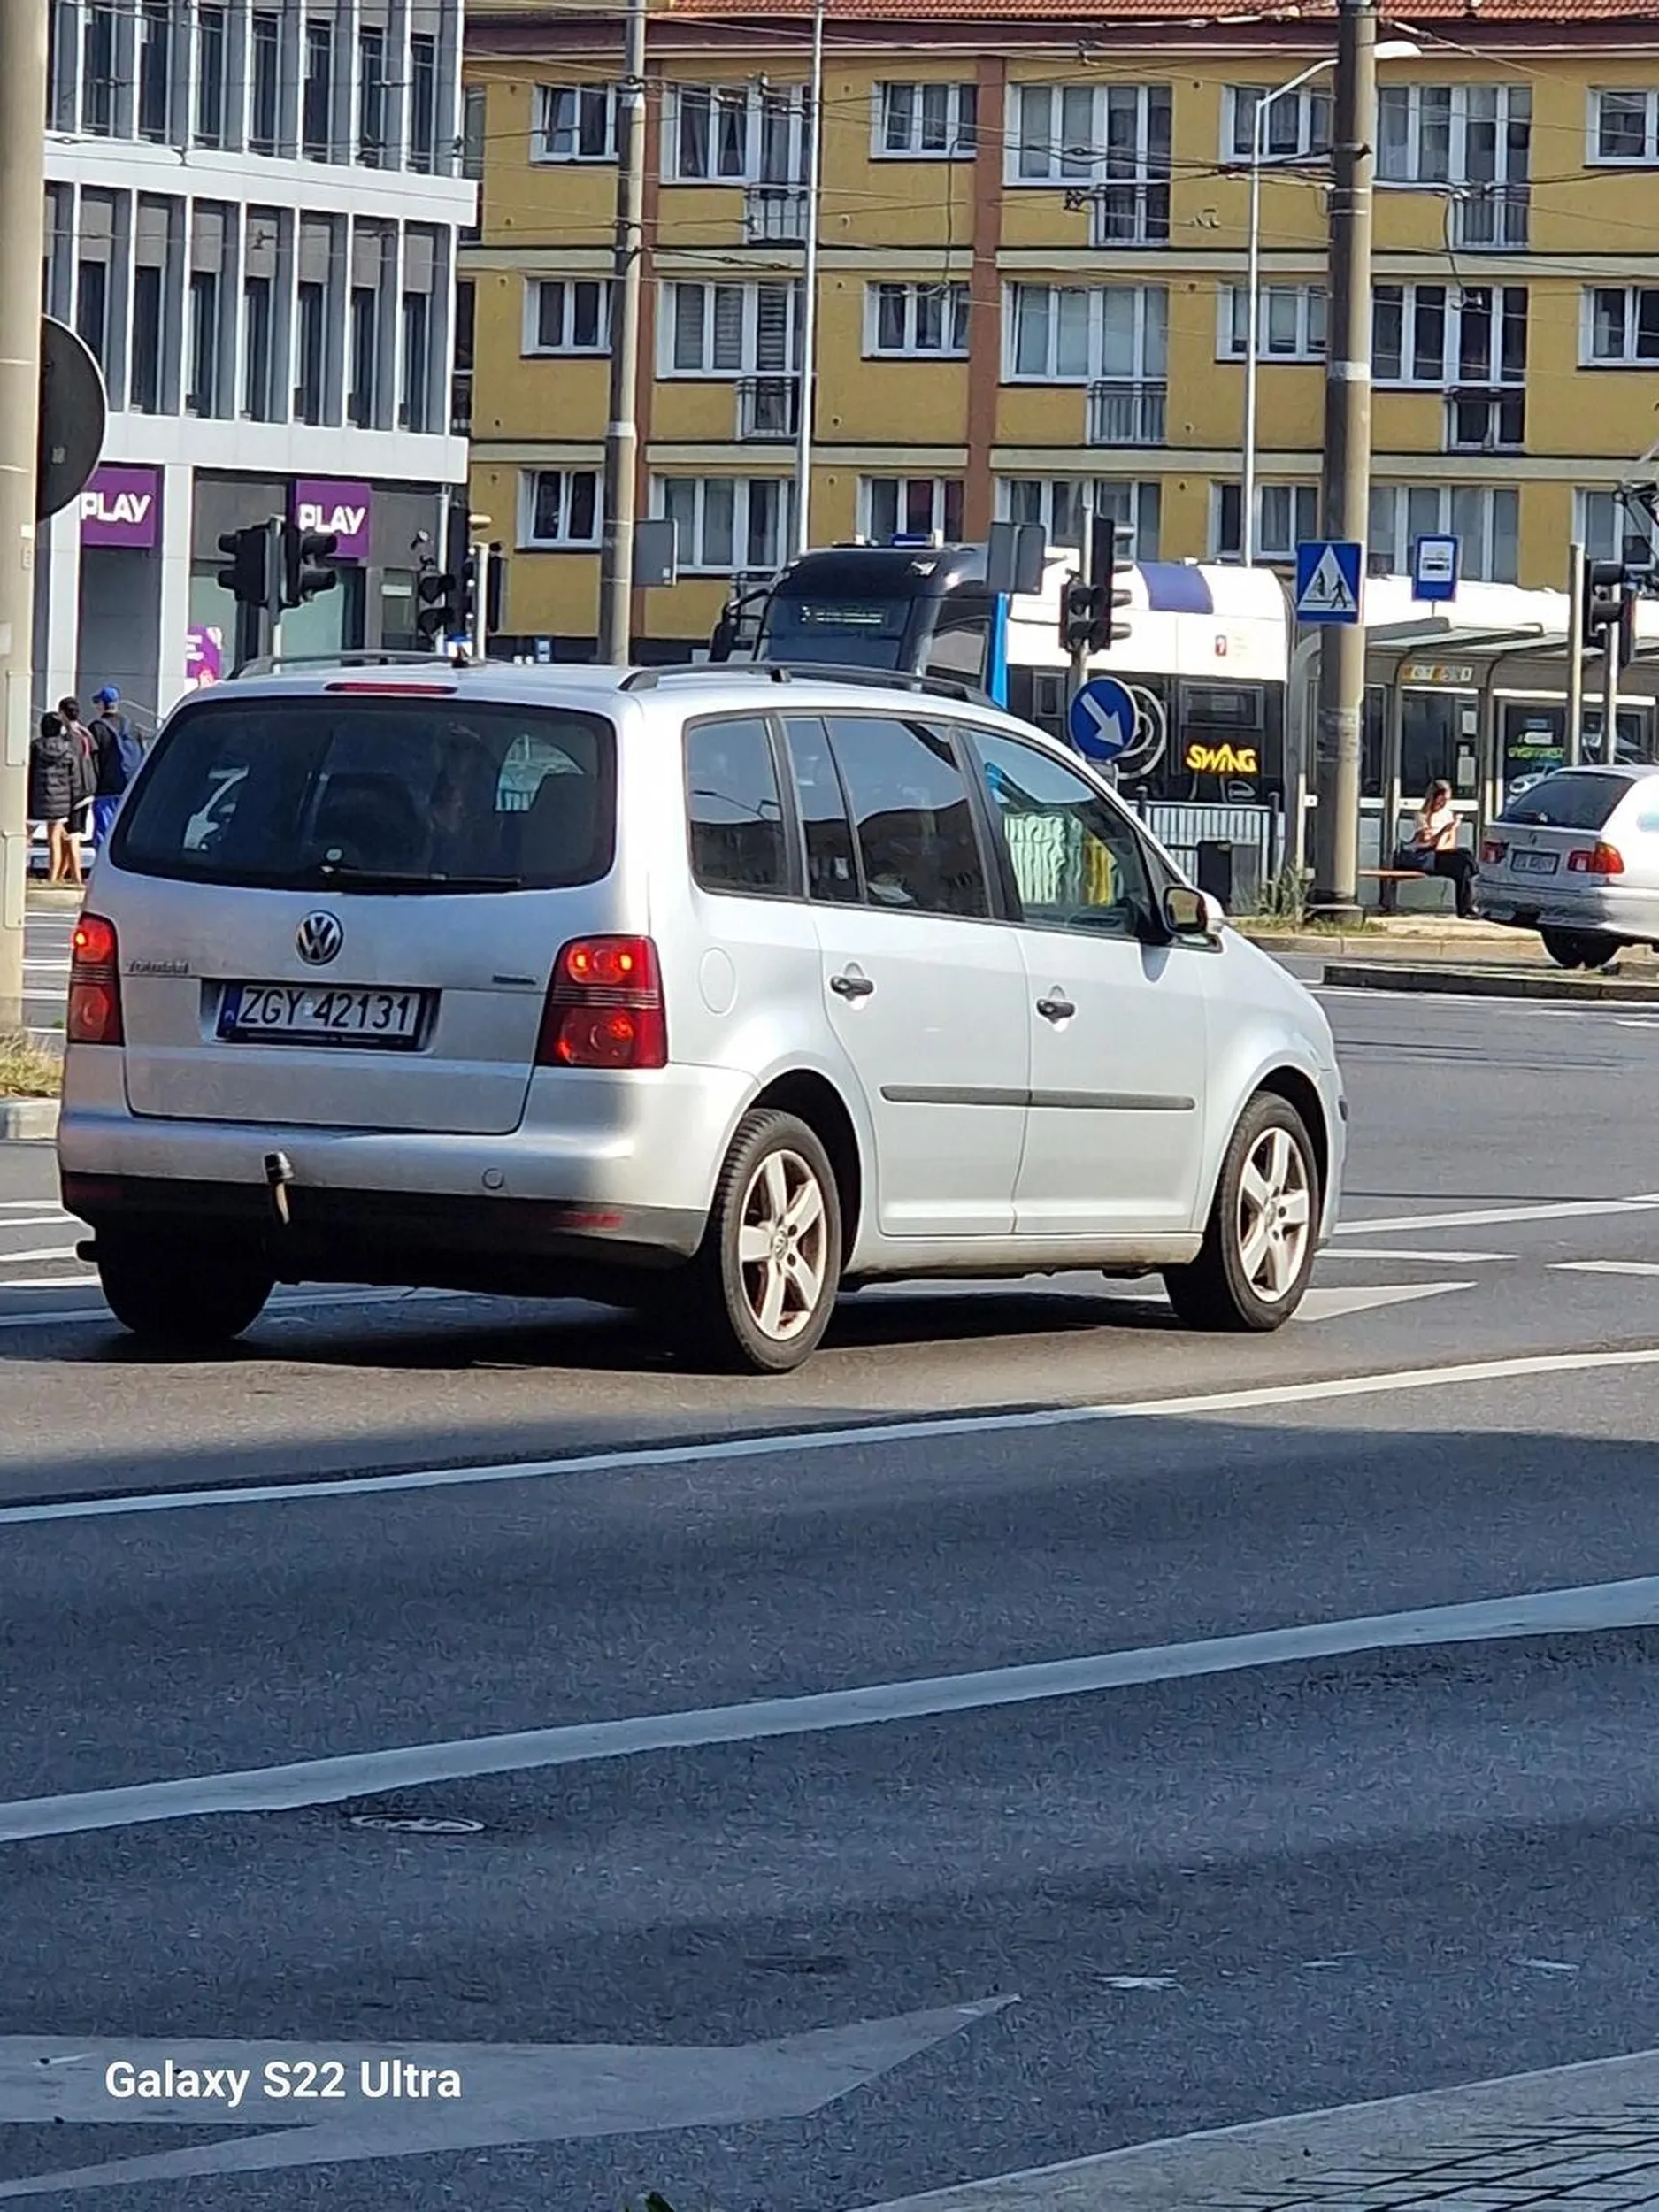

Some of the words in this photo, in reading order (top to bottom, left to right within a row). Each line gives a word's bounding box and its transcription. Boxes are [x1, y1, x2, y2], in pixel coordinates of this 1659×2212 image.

[81, 492, 151, 523] PLAY
[299, 504, 365, 534] PLAY
[239, 988, 305, 1025] ZGY
[313, 992, 411, 1031] 42131
